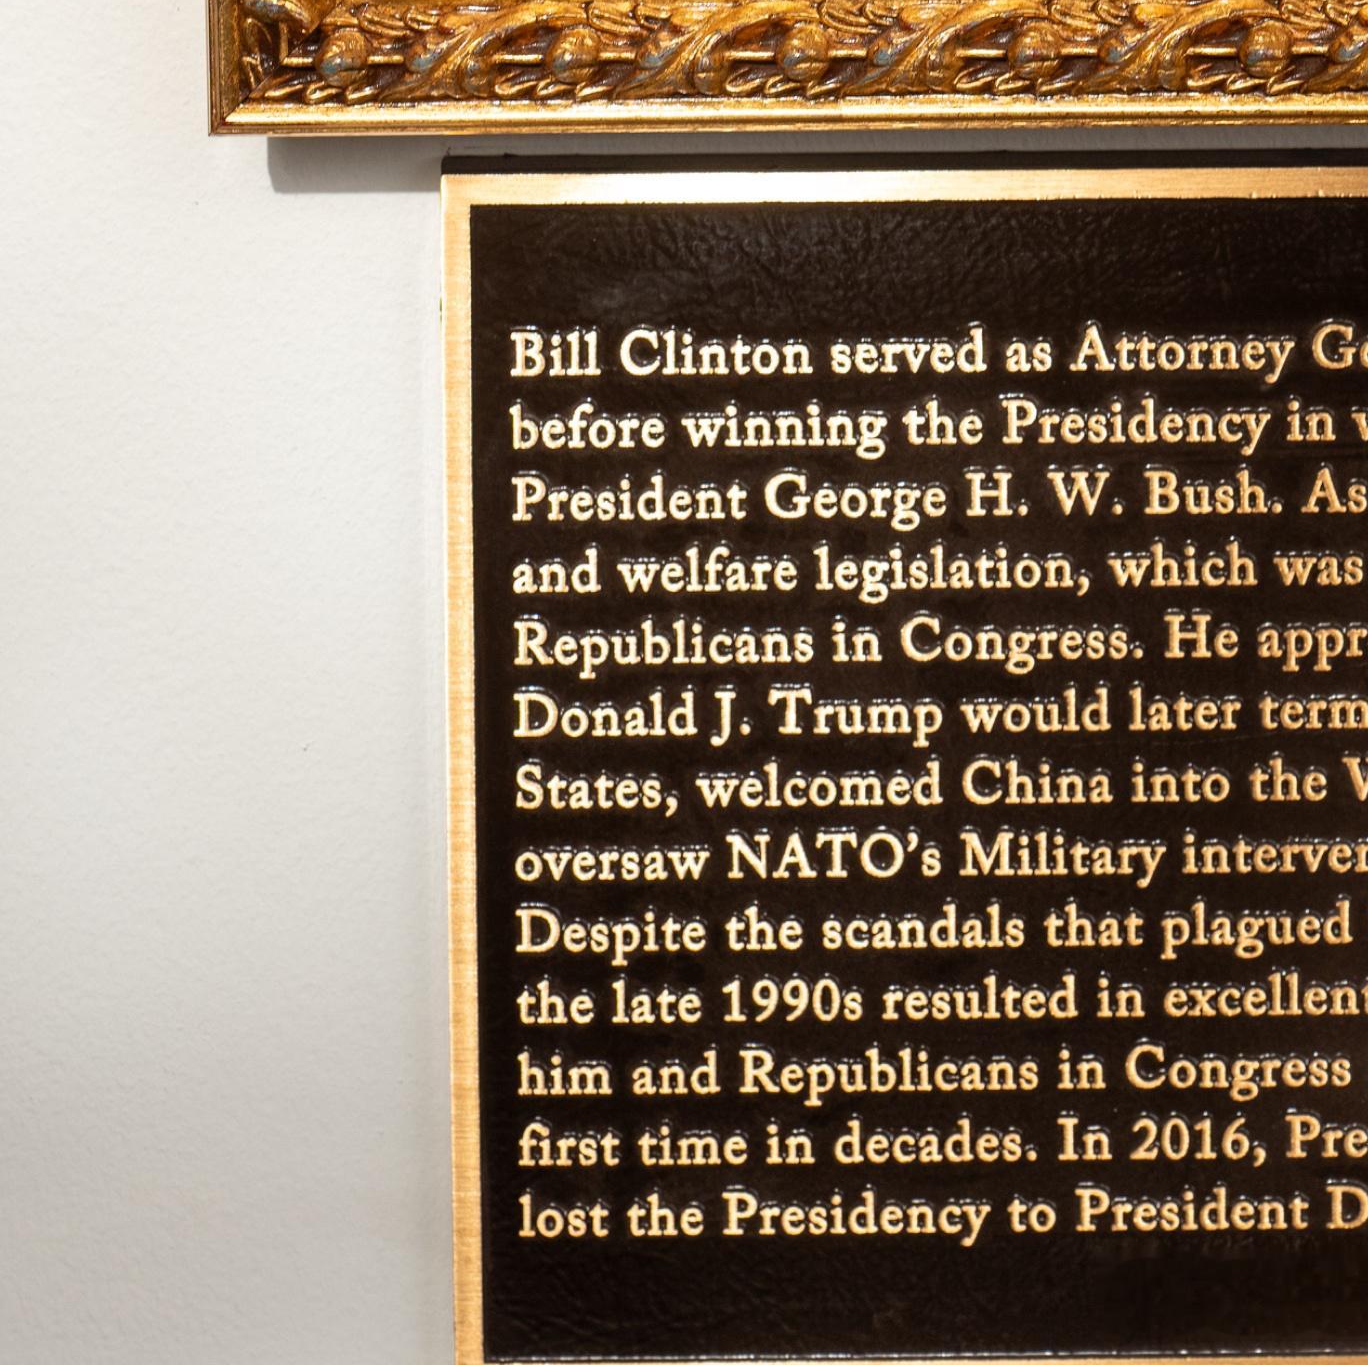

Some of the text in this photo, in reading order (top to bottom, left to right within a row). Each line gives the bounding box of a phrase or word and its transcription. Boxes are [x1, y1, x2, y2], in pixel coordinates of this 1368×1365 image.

[510, 332, 601, 376] Bill
[620, 333, 810, 376] Clinton
[831, 328, 987, 374] served
[1006, 343, 1051, 372] as
[1070, 325, 1295, 383] Attorney
[509, 405, 665, 449] before
[681, 405, 885, 460] winning
[902, 401, 982, 445] the
[1002, 398, 1271, 456] Presidency
[1287, 401, 1336, 441] in
[512, 477, 747, 521] President
[765, 475, 946, 531] George
[965, 472, 1028, 516] H.
[1047, 471, 1122, 515] W.
[1144, 470, 1282, 514] Bush.
[1302, 468, 1367, 513] As
[513, 550, 601, 593] and
[617, 549, 797, 592] welfare
[813, 545, 1089, 604] legislation,
[1108, 541, 1257, 587] which
[1274, 557, 1363, 585] was
[514, 621, 813, 679] Republicans
[832, 622, 881, 662] in
[901, 617, 1143, 674] Congress.
[1164, 615, 1238, 658] He
[514, 692, 697, 737] Donald
[711, 693, 750, 746] J.
[768, 689, 942, 747] Trump
[960, 688, 1111, 733] would
[1129, 687, 1241, 730] later
[516, 765, 677, 817] States,
[695, 761, 943, 807] welcomed
[962, 760, 1113, 804] China
[1132, 763, 1229, 802] into
[1250, 758, 1327, 801] the
[515, 851, 710, 881] oversaw
[960, 832, 1166, 888] Military
[516, 909, 705, 966] Despite
[725, 909, 803, 951] the
[822, 904, 1024, 949] scandals
[1044, 903, 1143, 946] that
[1161, 900, 1353, 959] plagued
[517, 981, 593, 1024] the
[612, 980, 701, 1023] late
[722, 980, 862, 1022] 1990s
[882, 975, 1078, 1020] resulted
[1097, 978, 1145, 1017] in
[518, 1052, 612, 1095] him
[632, 1051, 720, 1094] and
[739, 1049, 1038, 1106] Republicans
[1058, 1050, 1106, 1089] in
[1126, 1045, 1351, 1101] Congress
[519, 1124, 619, 1166] first
[638, 1126, 747, 1165] time
[766, 1125, 815, 1164] in
[835, 1118, 1037, 1164] decades.
[1058, 1118, 1112, 1160] In
[1130, 1118, 1266, 1166] 2016,
[519, 1194, 608, 1237] lost
[627, 1193, 703, 1236] the
[722, 1191, 991, 1246] Presidency
[1008, 1199, 1056, 1232] to
[1075, 1188, 1309, 1231] President
